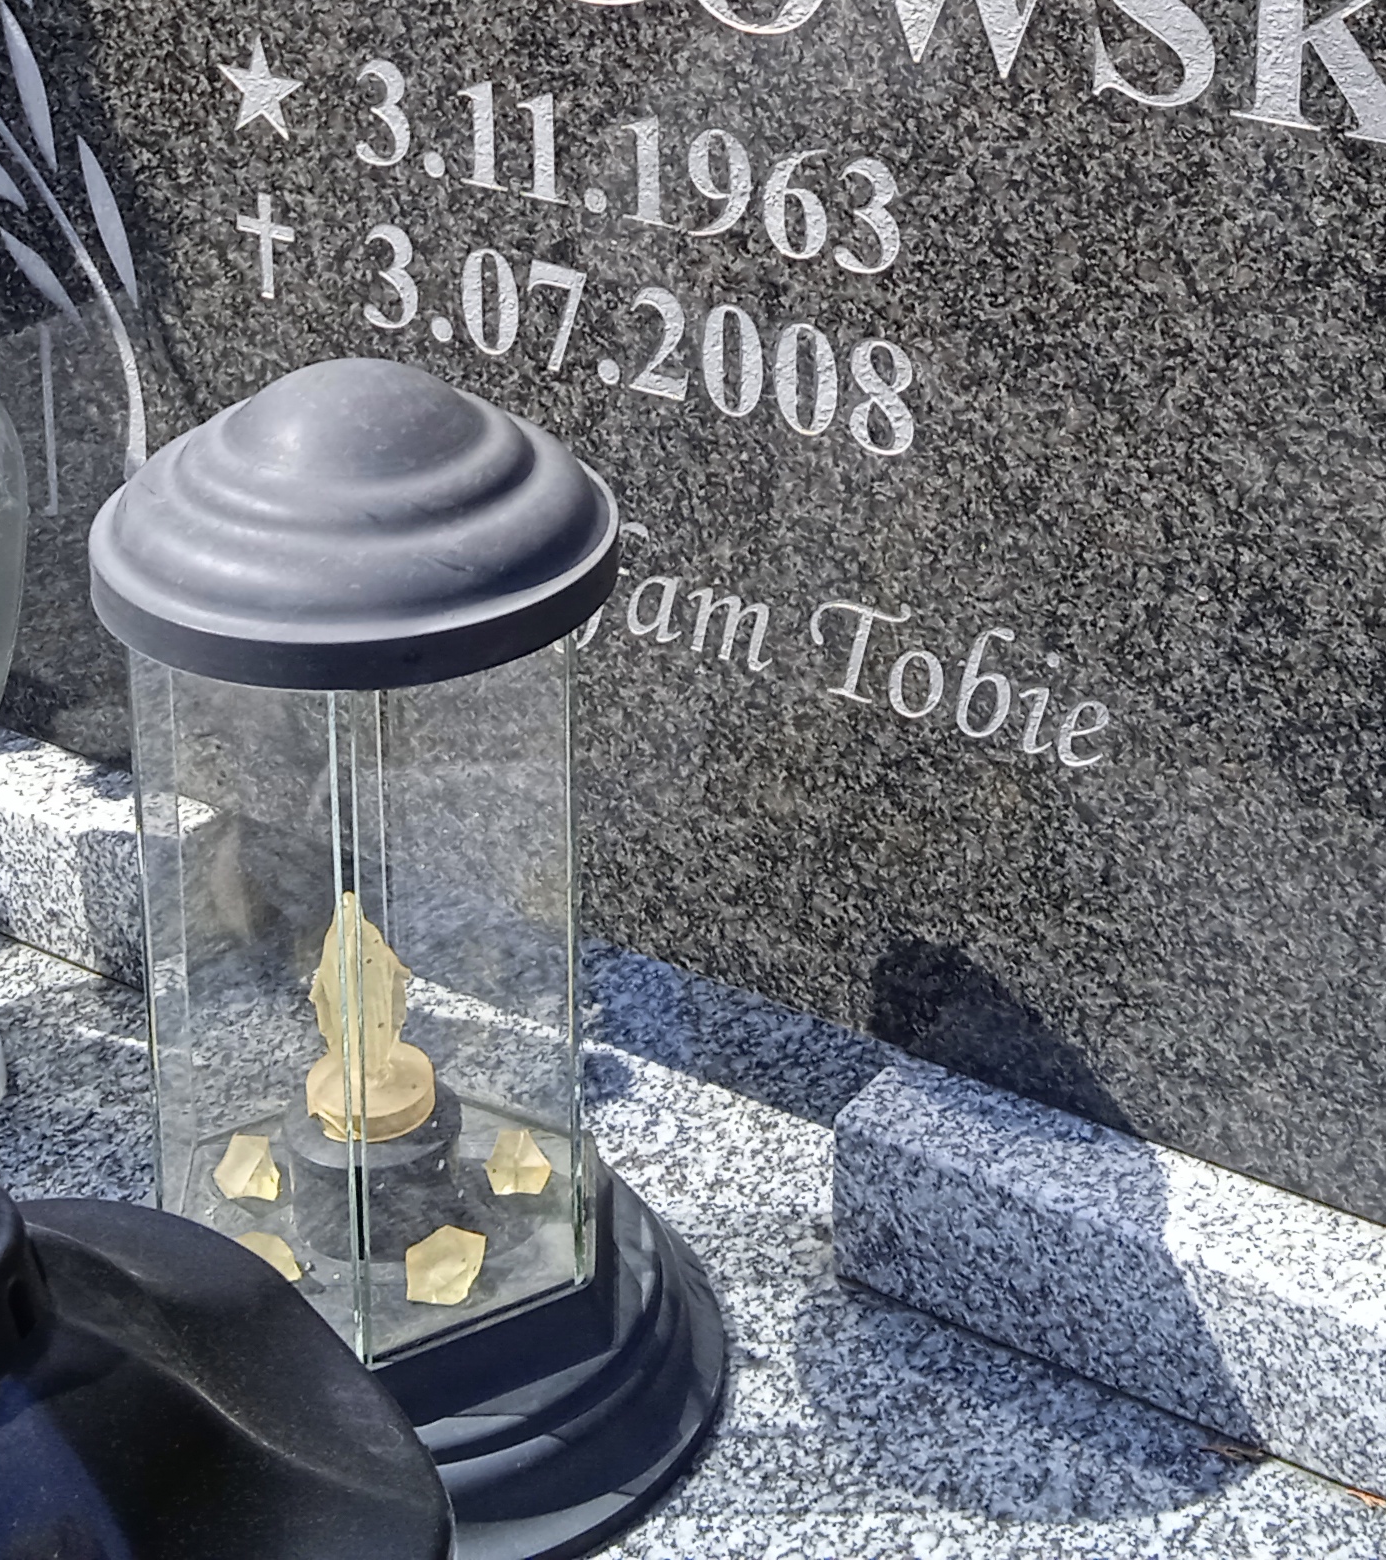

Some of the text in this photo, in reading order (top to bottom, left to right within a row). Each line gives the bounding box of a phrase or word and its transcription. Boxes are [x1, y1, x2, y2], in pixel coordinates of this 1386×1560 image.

[355, 58, 903, 274] 3.11.1963
[363, 222, 916, 457] 3.07.2008
[810, 598, 1110, 768] Tobie
